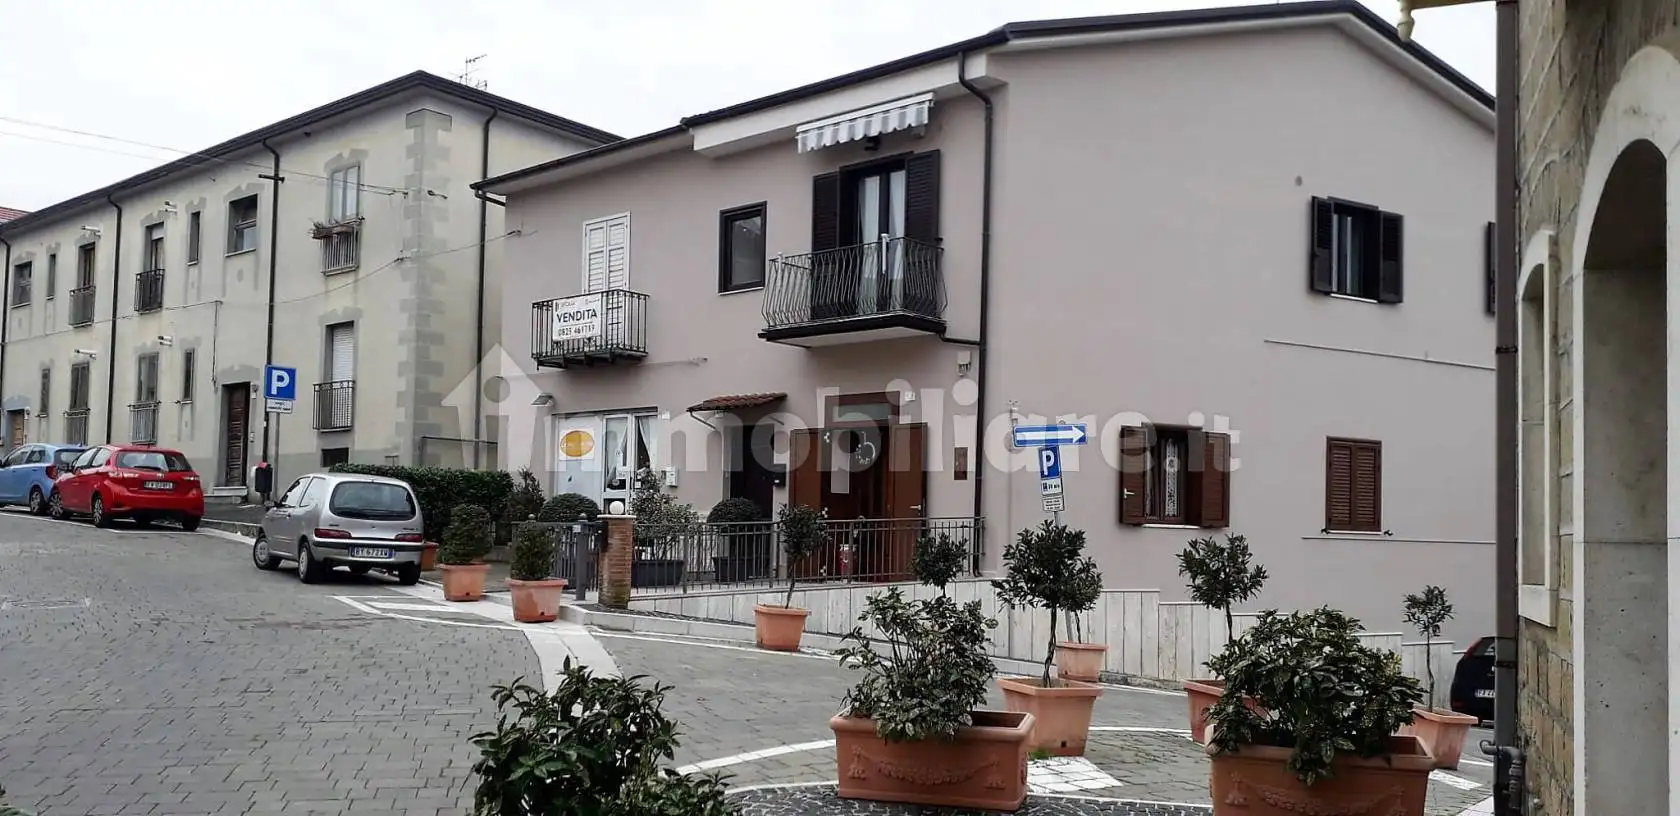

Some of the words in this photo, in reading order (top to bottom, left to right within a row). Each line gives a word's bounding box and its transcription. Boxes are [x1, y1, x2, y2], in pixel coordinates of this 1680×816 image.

[556, 308, 598, 323] VENDITA
[271, 369, 290, 395] P
[1042, 450, 1055, 475] P
